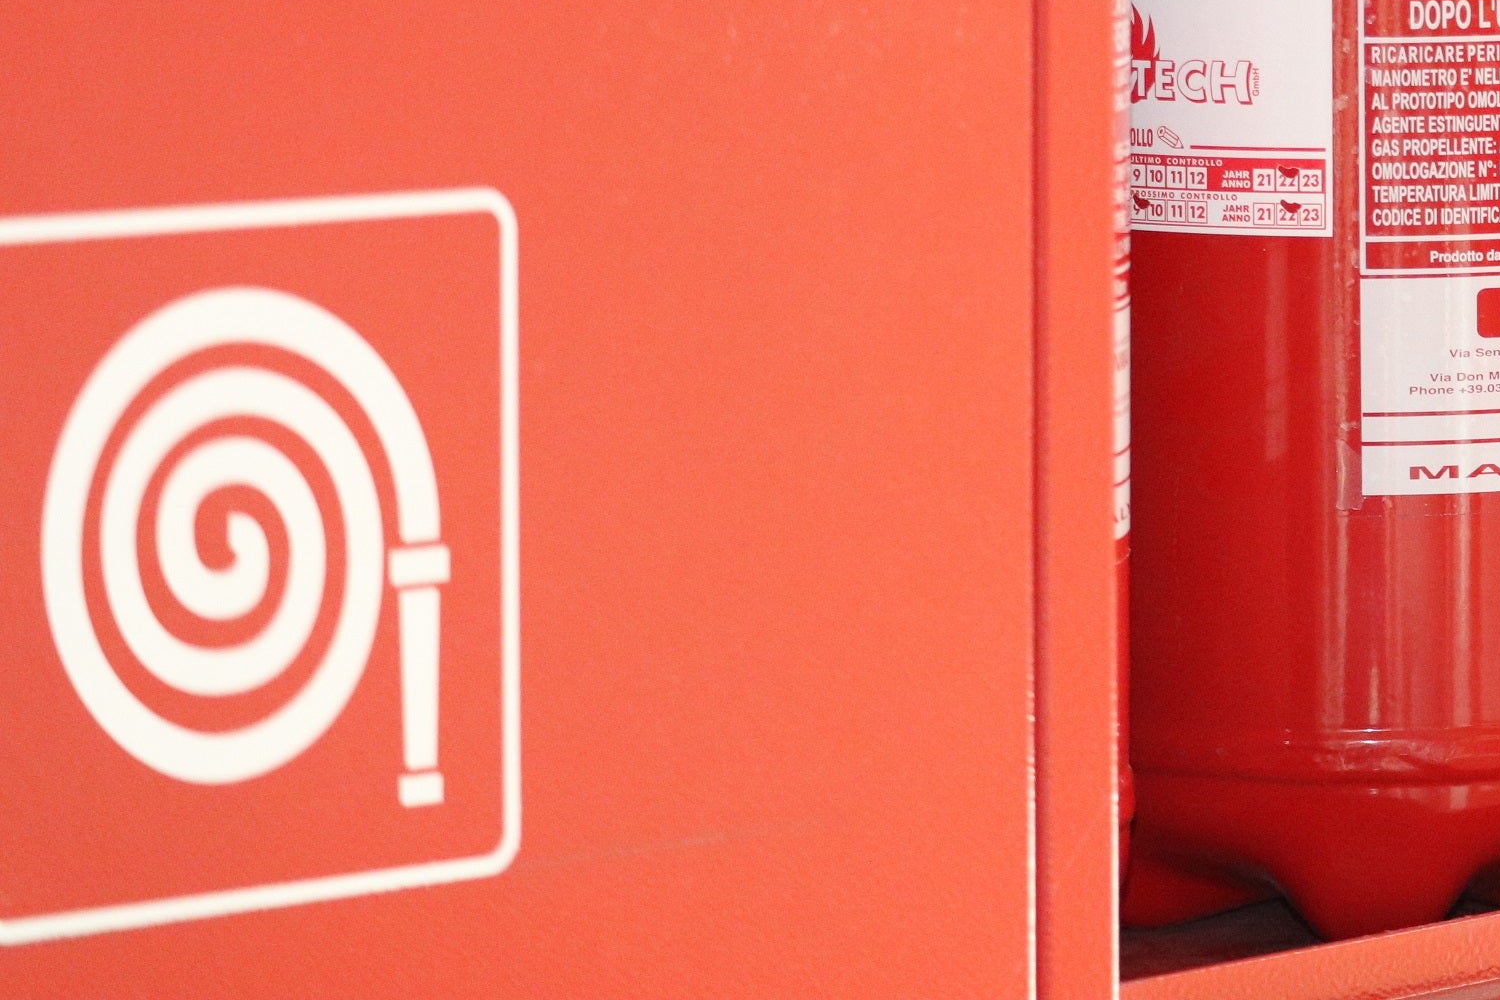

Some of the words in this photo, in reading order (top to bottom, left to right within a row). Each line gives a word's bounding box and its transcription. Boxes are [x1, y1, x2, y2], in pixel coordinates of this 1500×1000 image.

[1409, 0, 1472, 30] DOPO
[1371, 45, 1464, 64] RICARICARE
[1371, 68, 1457, 87] MANOMETRO
[1371, 92, 1389, 111] AL
[1392, 91, 1465, 110] PROTOTIPO
[1372, 115, 1425, 134] AGENTE
[1372, 138, 1400, 157] GAS
[1403, 137, 1497, 156] PROPELLENTE:
[1166, 157, 1223, 167] CONTROLLO
[1372, 161, 1475, 180] OMOLOGAZIONE
[1150, 169, 1163, 182] 10
[1170, 170, 1183, 184] 11
[1190, 171, 1205, 185] 12
[1222, 170, 1250, 179] JAHR
[1257, 173, 1272, 186] 21
[1303, 174, 1319, 187] 23
[1221, 179, 1251, 189] ANNO
[1180, 192, 1238, 202] CONTROLLO
[1372, 184, 1466, 203] TEMPERATURA
[1150, 204, 1163, 217] 10
[1170, 205, 1183, 218] 11
[1190, 206, 1206, 219] 12
[1223, 204, 1250, 213] JAHR
[1257, 207, 1272, 221] 21
[1303, 208, 1319, 222] 23
[1222, 213, 1251, 223] ANNO
[1372, 207, 1422, 226] CODICE
[1425, 207, 1437, 225] DI
[1430, 250, 1483, 264] Prodotto
[1450, 349, 1470, 358] Via
[1430, 373, 1452, 382] Via
[1456, 372, 1484, 382] Don
[1409, 386, 1454, 396] Phone
